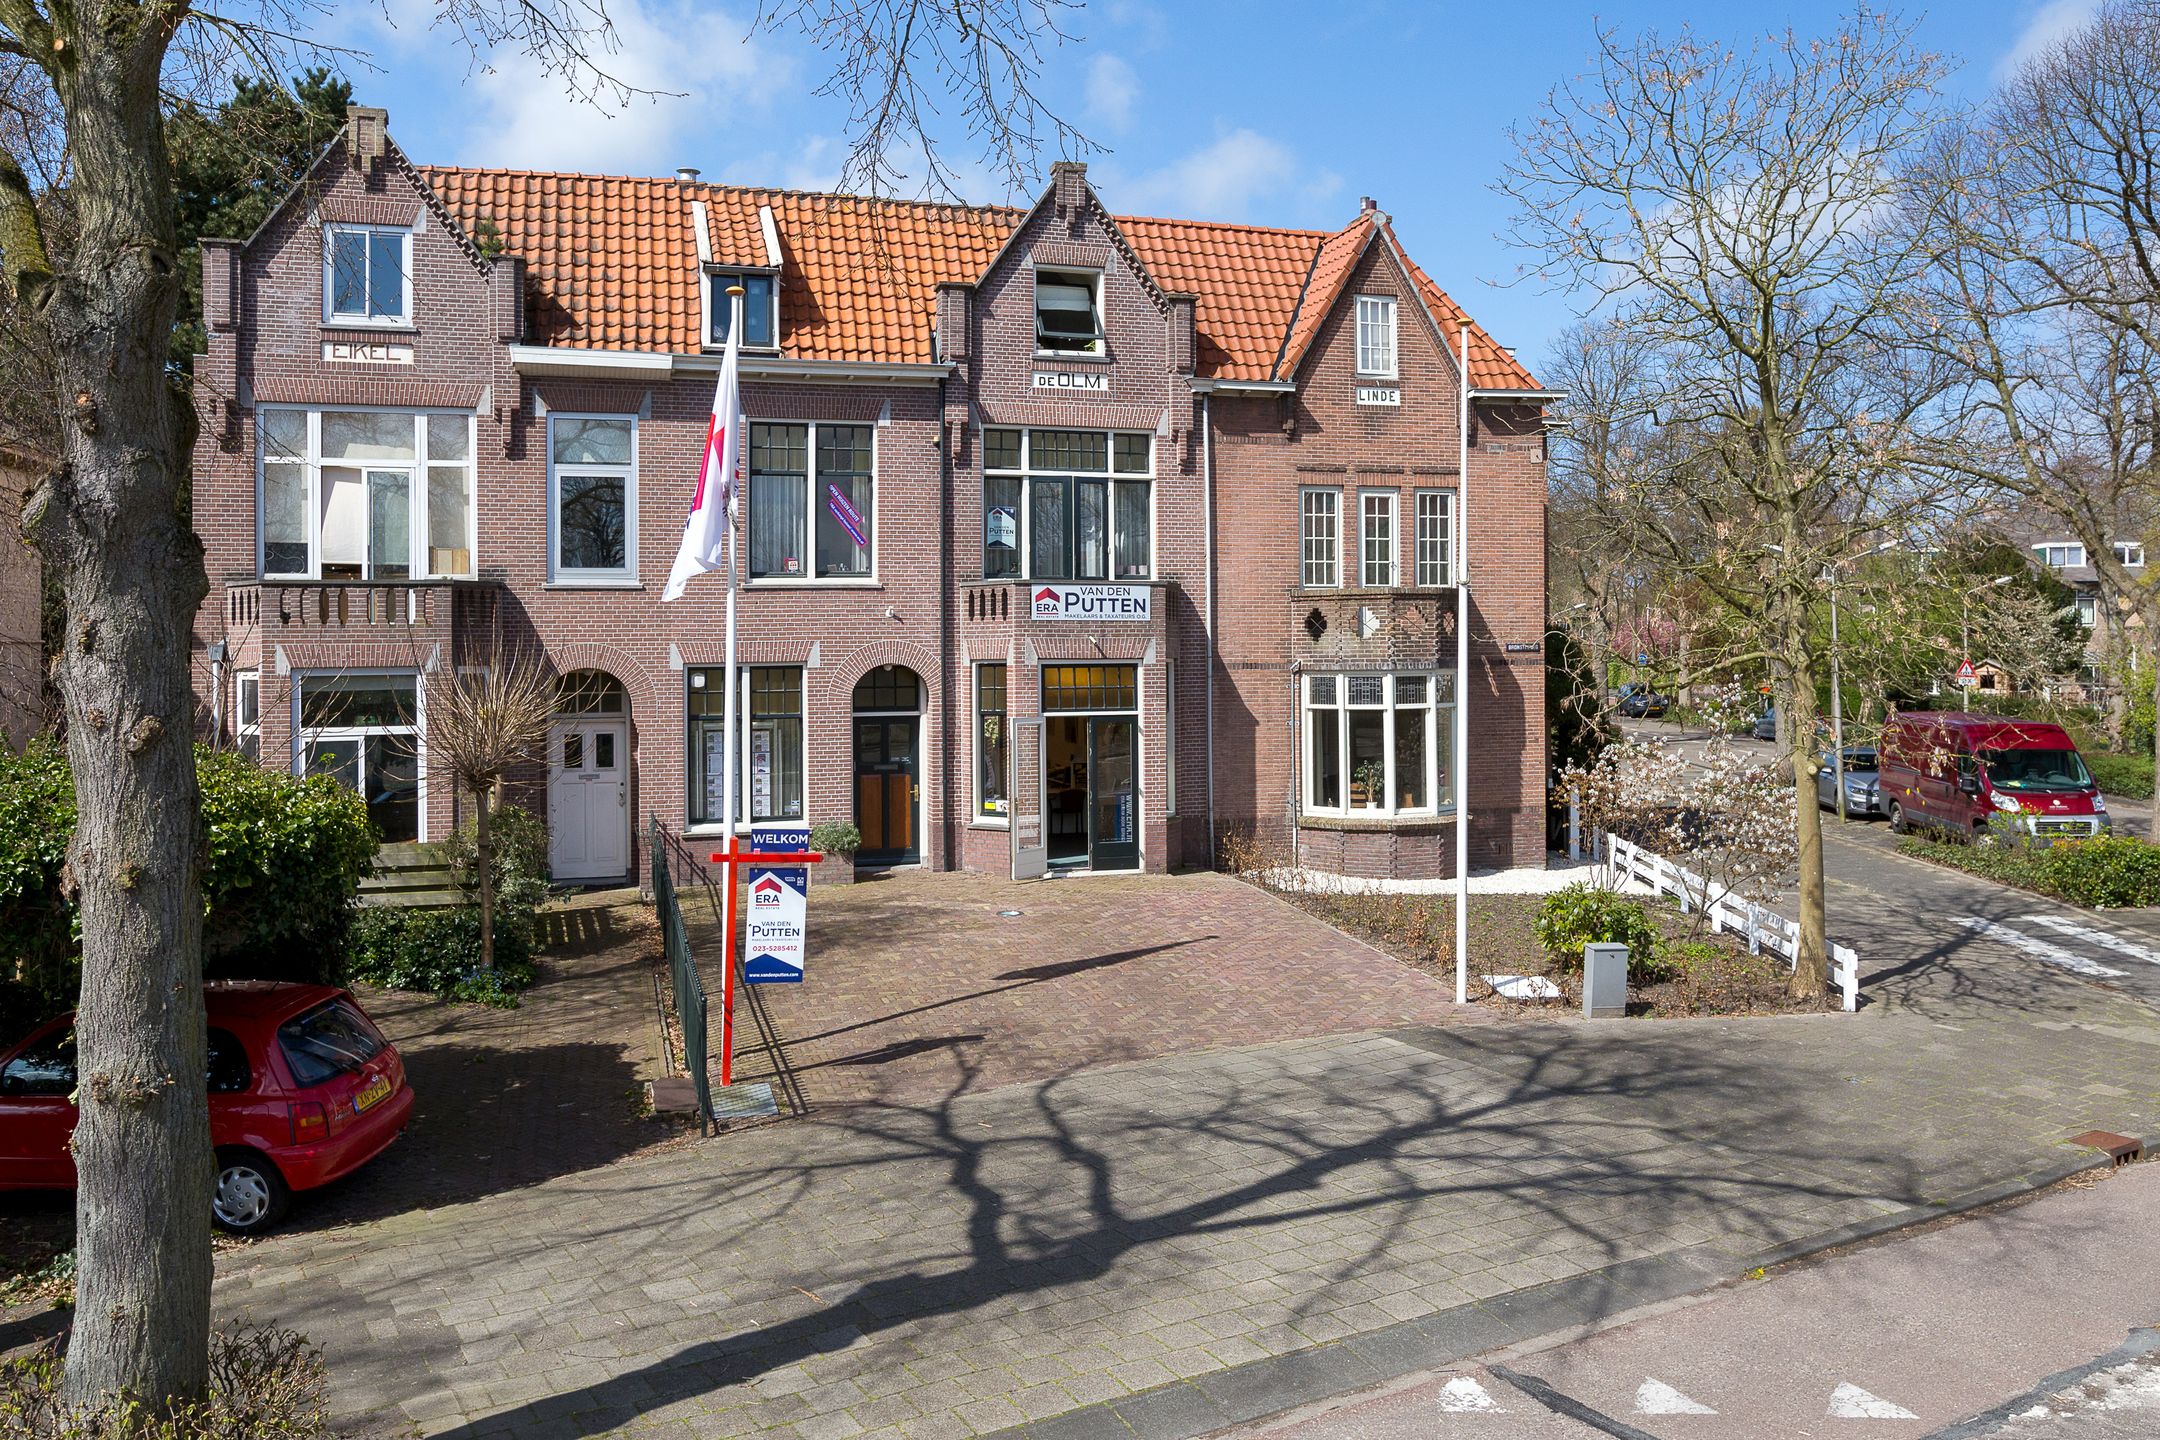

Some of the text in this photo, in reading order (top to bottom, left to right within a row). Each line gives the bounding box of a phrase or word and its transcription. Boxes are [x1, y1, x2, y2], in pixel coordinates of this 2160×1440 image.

[333, 343, 401, 360] EIKEL
[1039, 373, 1100, 389] DE OLM
[1359, 390, 1396, 402] LINDE
[990, 527, 1014, 535] PUTTEN
[1080, 587, 1131, 597] VAN DEN
[1036, 604, 1059, 612] ERA
[1065, 592, 1146, 613] PUTTEN
[752, 834, 809, 844] WELKOM
[756, 894, 780, 904] ERA
[752, 925, 800, 937] PUTTEN
